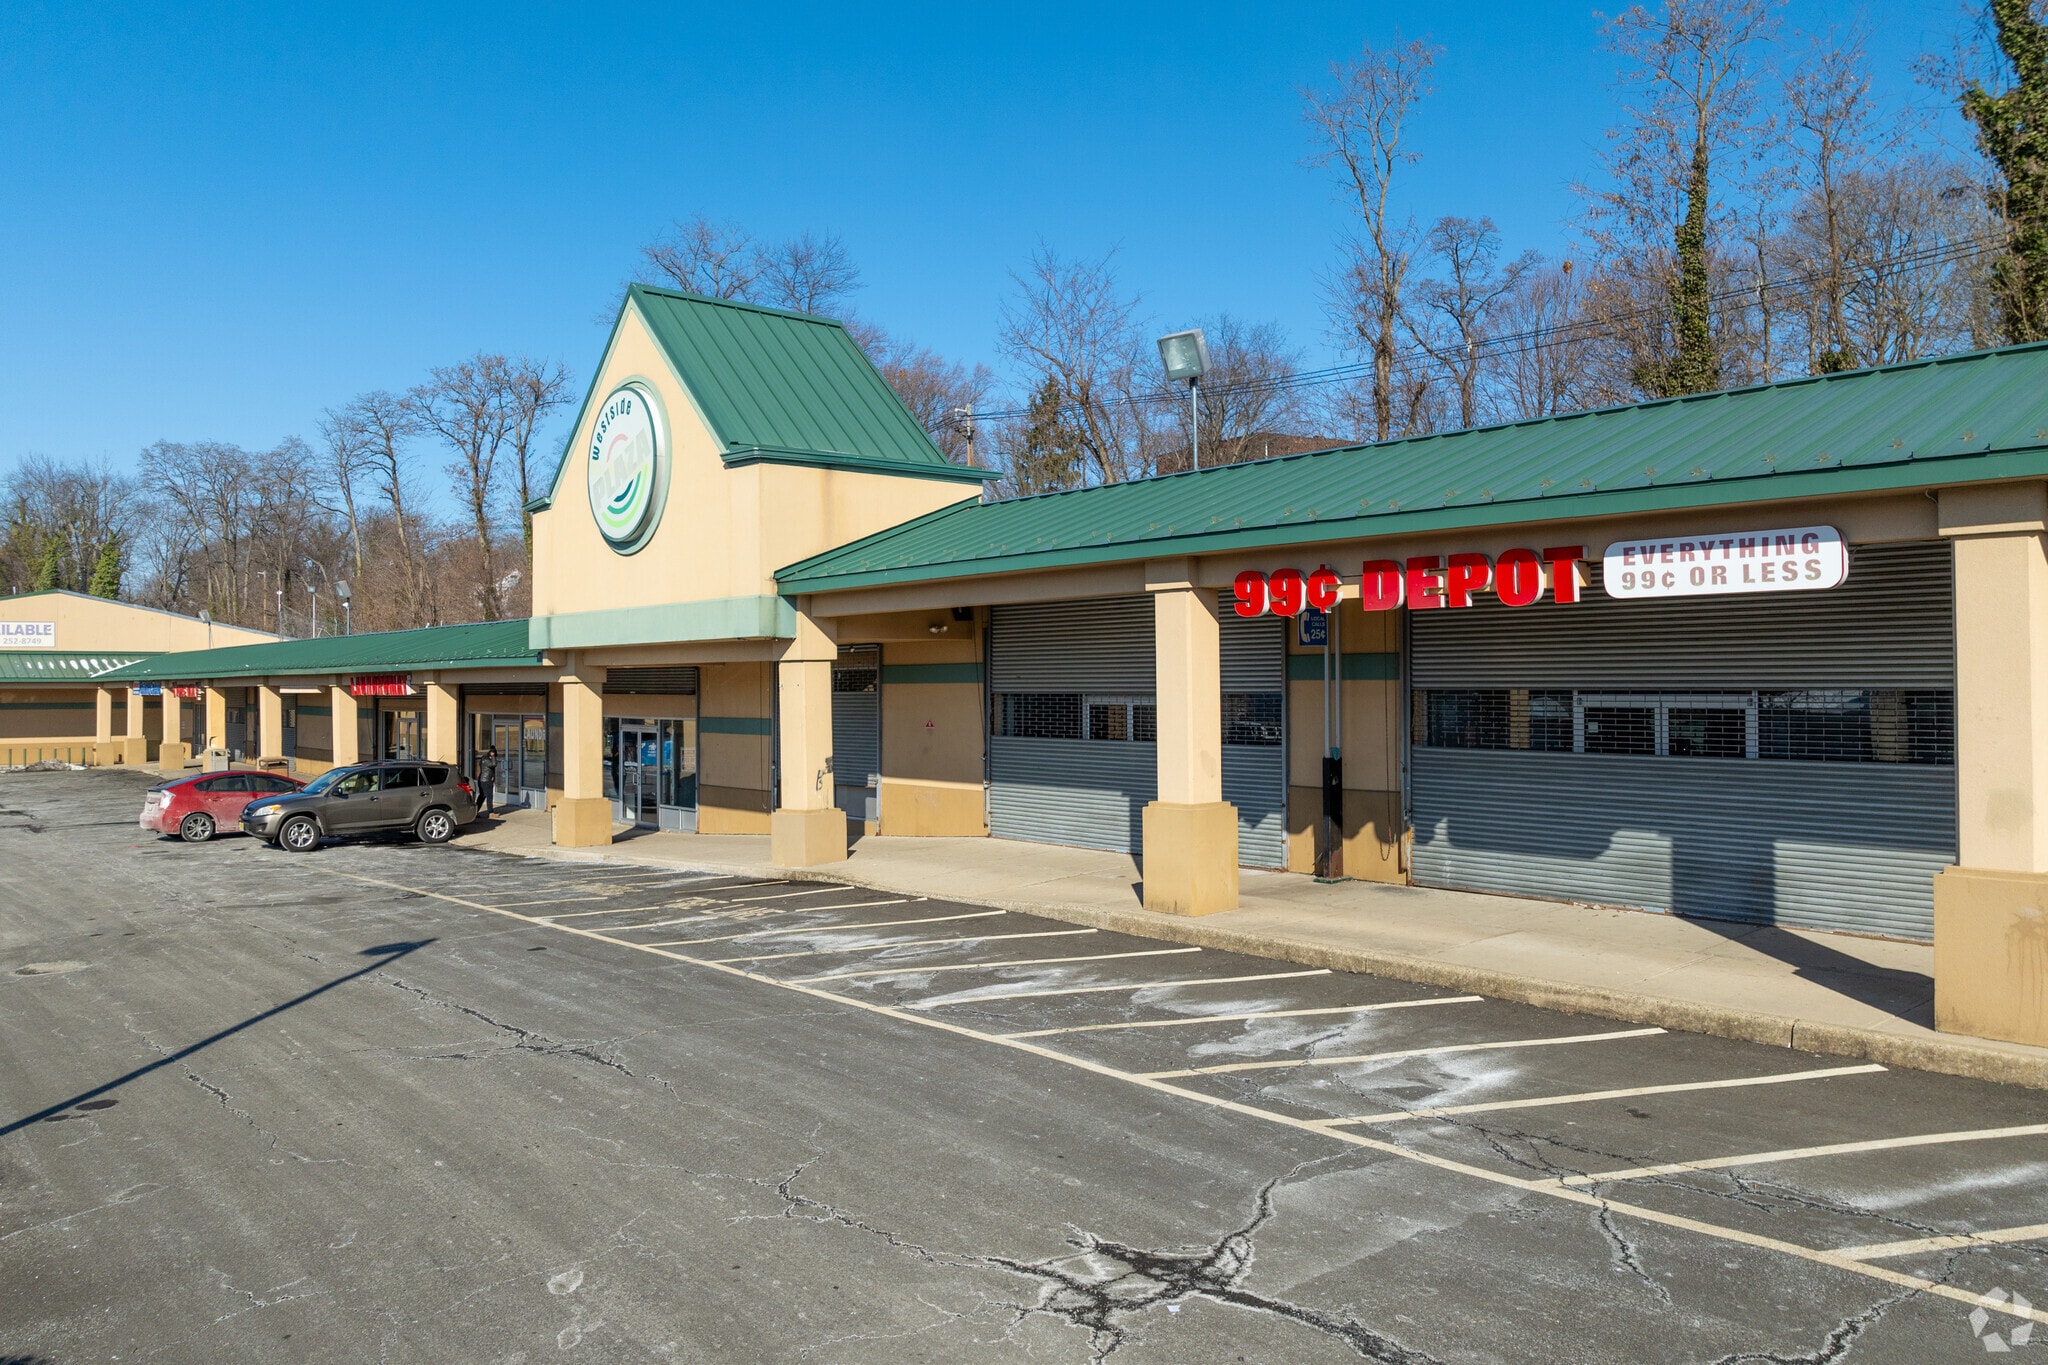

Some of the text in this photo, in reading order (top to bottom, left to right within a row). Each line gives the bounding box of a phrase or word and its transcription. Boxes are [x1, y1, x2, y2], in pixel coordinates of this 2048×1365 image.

[592, 398, 632, 461] westside
[592, 428, 650, 512] PLAZA
[1622, 532, 1820, 567] EVERYTHING
[1233, 545, 1588, 618] 99¢ DEPOT
[1621, 558, 1822, 590] 99¢ OR LESS
[0, 624, 52, 635] ILABLE
[3, 637, 42, 645] 252-8749
[1310, 629, 1326, 639] 25¢
